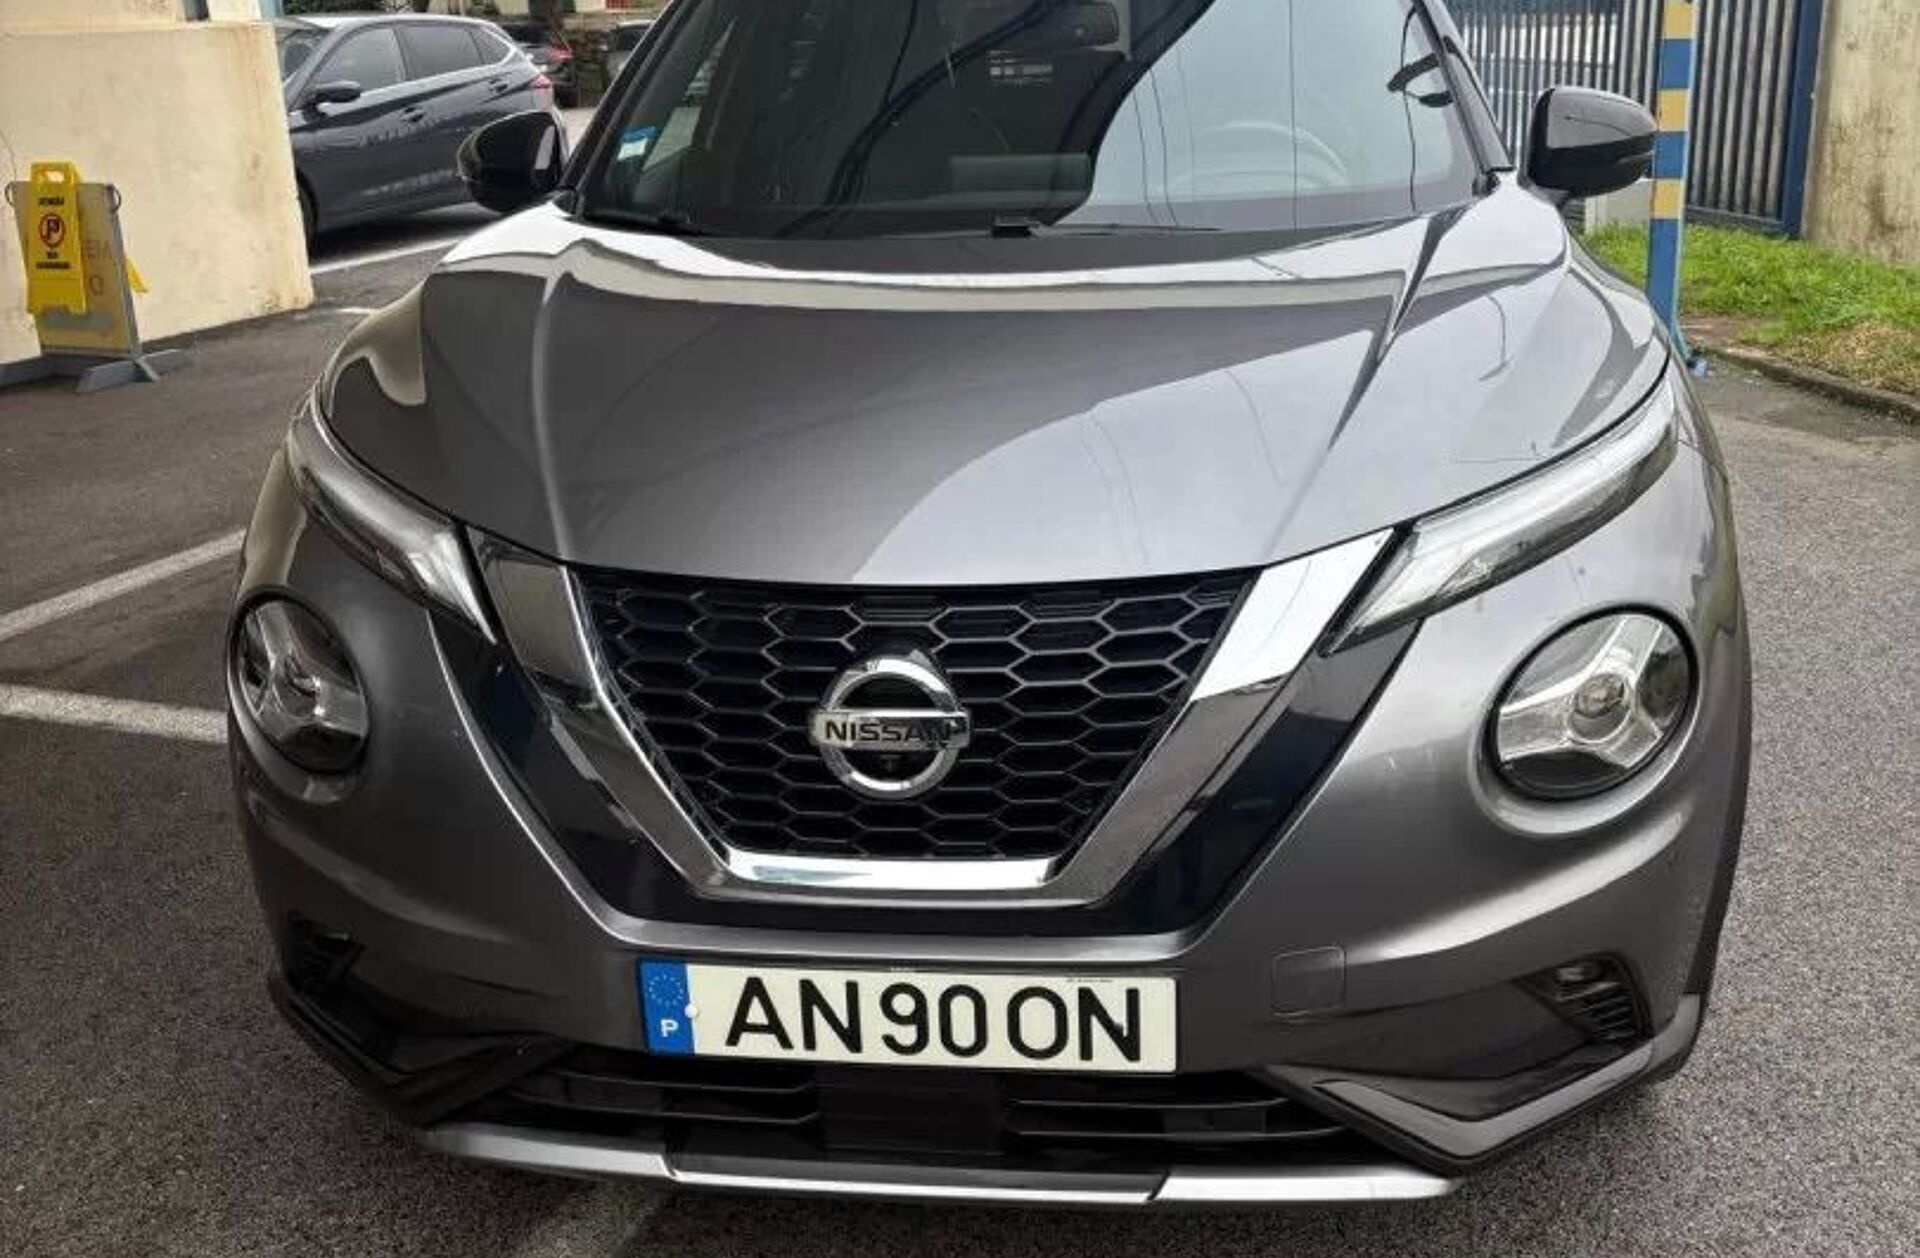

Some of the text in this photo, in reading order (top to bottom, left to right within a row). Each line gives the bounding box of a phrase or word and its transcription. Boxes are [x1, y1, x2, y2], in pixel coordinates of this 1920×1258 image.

[825, 719, 951, 742] NISSAN
[661, 1019, 679, 1037] P
[725, 976, 1141, 1062] AN 90 ON
